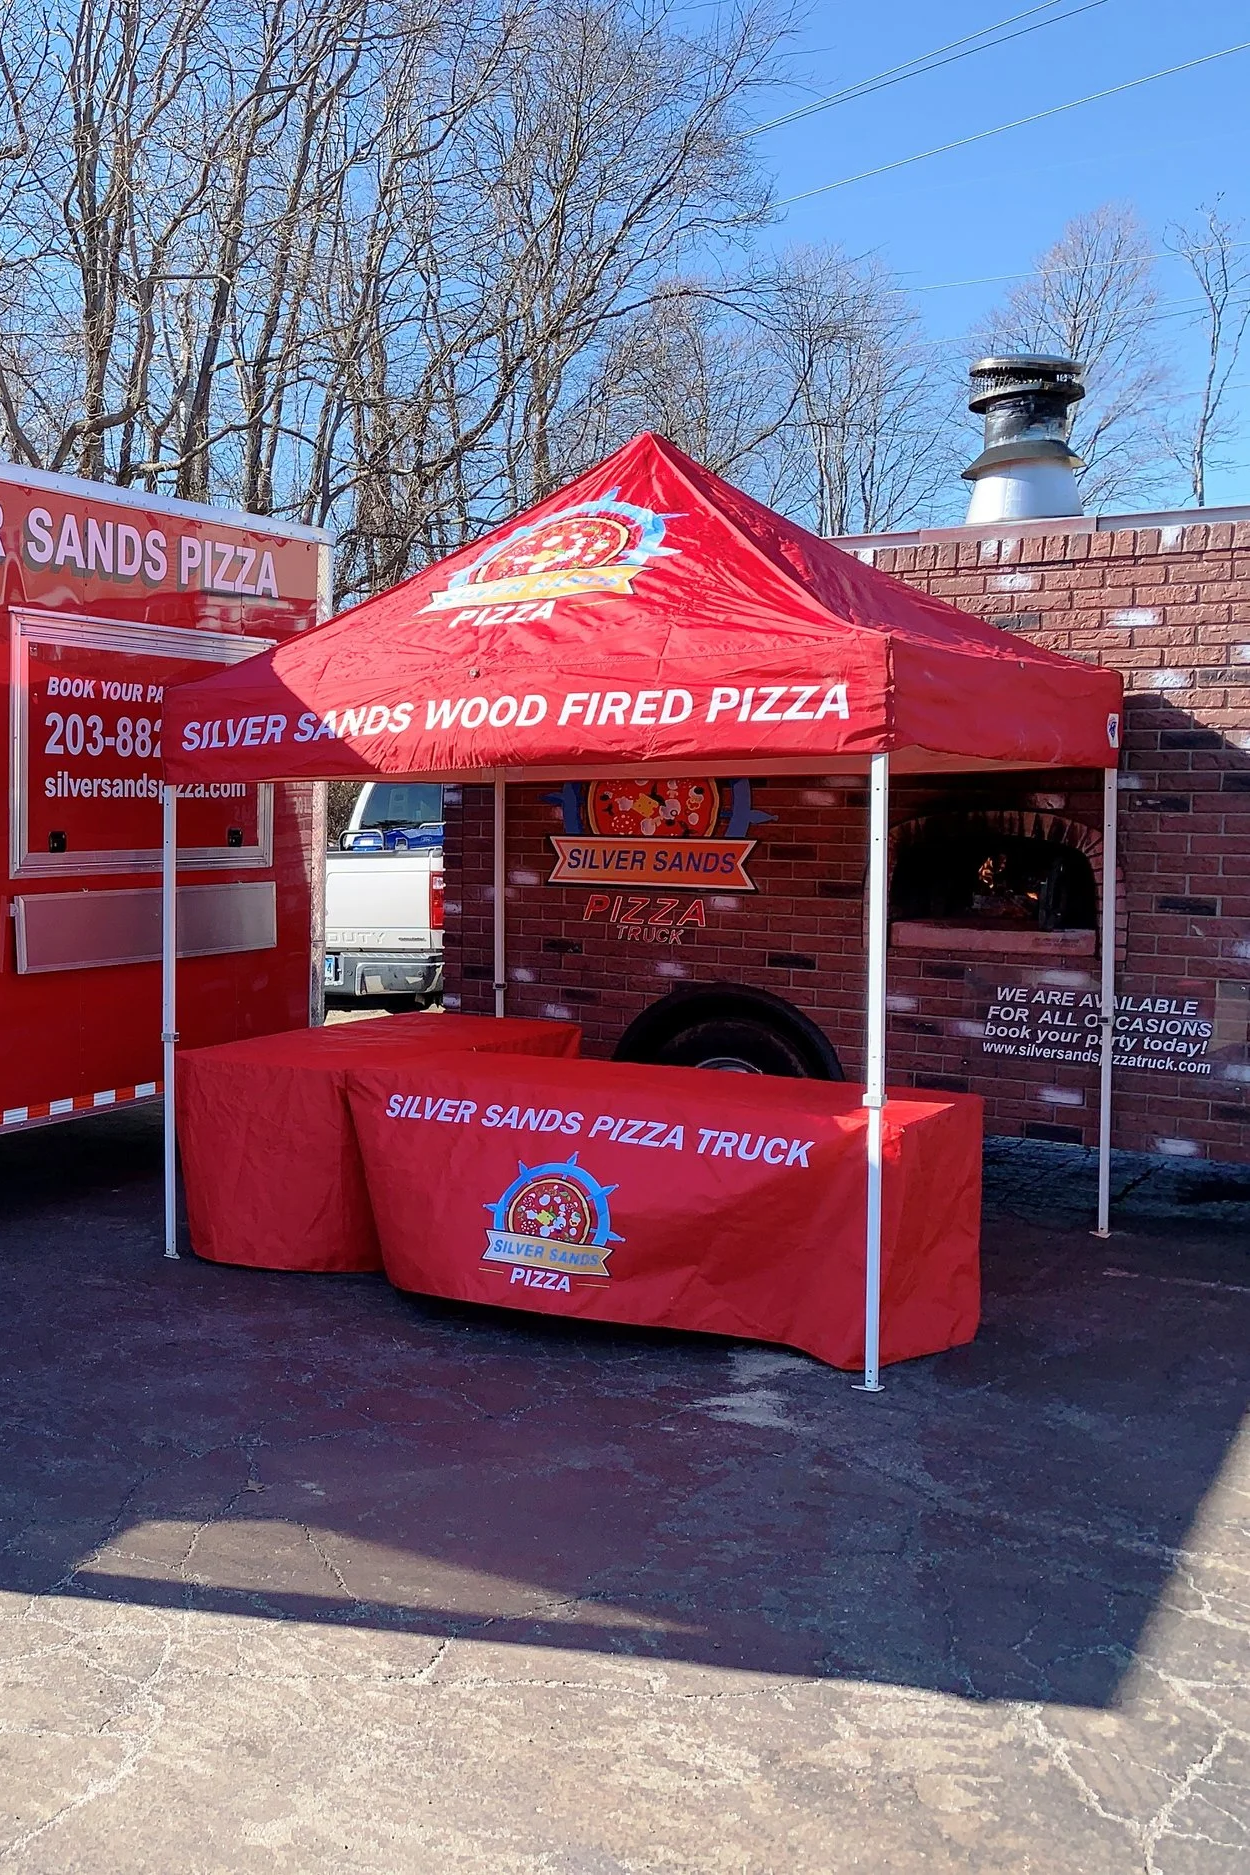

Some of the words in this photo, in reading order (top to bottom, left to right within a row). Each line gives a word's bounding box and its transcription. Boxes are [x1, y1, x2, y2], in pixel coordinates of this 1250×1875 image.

[26, 506, 168, 584] SANDS
[179, 537, 279, 599] PIZZA
[448, 600, 557, 628] PIZZA
[47, 676, 97, 699] BOOK
[101, 680, 143, 702] YOUR
[181, 713, 288, 751] SILVER
[293, 702, 414, 742] SANDS
[425, 693, 549, 732] WOOD
[558, 687, 694, 726] FIRED
[705, 684, 851, 723] PIZZA
[44, 771, 247, 804] silversandszza.com
[567, 847, 647, 870] SILVER
[653, 850, 736, 874] SANDS
[582, 894, 707, 928] PIZZA
[616, 925, 685, 945] TRUCK
[996, 986, 1029, 1003] WE
[1031, 990, 1076, 1006] ARE
[987, 1005, 1030, 1022] FOR
[1037, 1010, 1078, 1026] ALL
[1084, 1013, 1214, 1037] OCASIONS
[984, 1022, 1031, 1039] book
[1036, 1030, 1082, 1045] your
[1084, 1032, 1138, 1052] prty
[1142, 1036, 1209, 1058] today!
[982, 1040, 1212, 1075] www.silversandszzatruck.com
[385, 1093, 478, 1124] SILVER
[481, 1104, 586, 1135] SANDS
[588, 1115, 685, 1151] PIZZA
[696, 1128, 817, 1168] TRUCK
[493, 1238, 546, 1260] SILVER
[548, 1248, 600, 1267] SANDS
[509, 1267, 572, 1293] PIZZA
